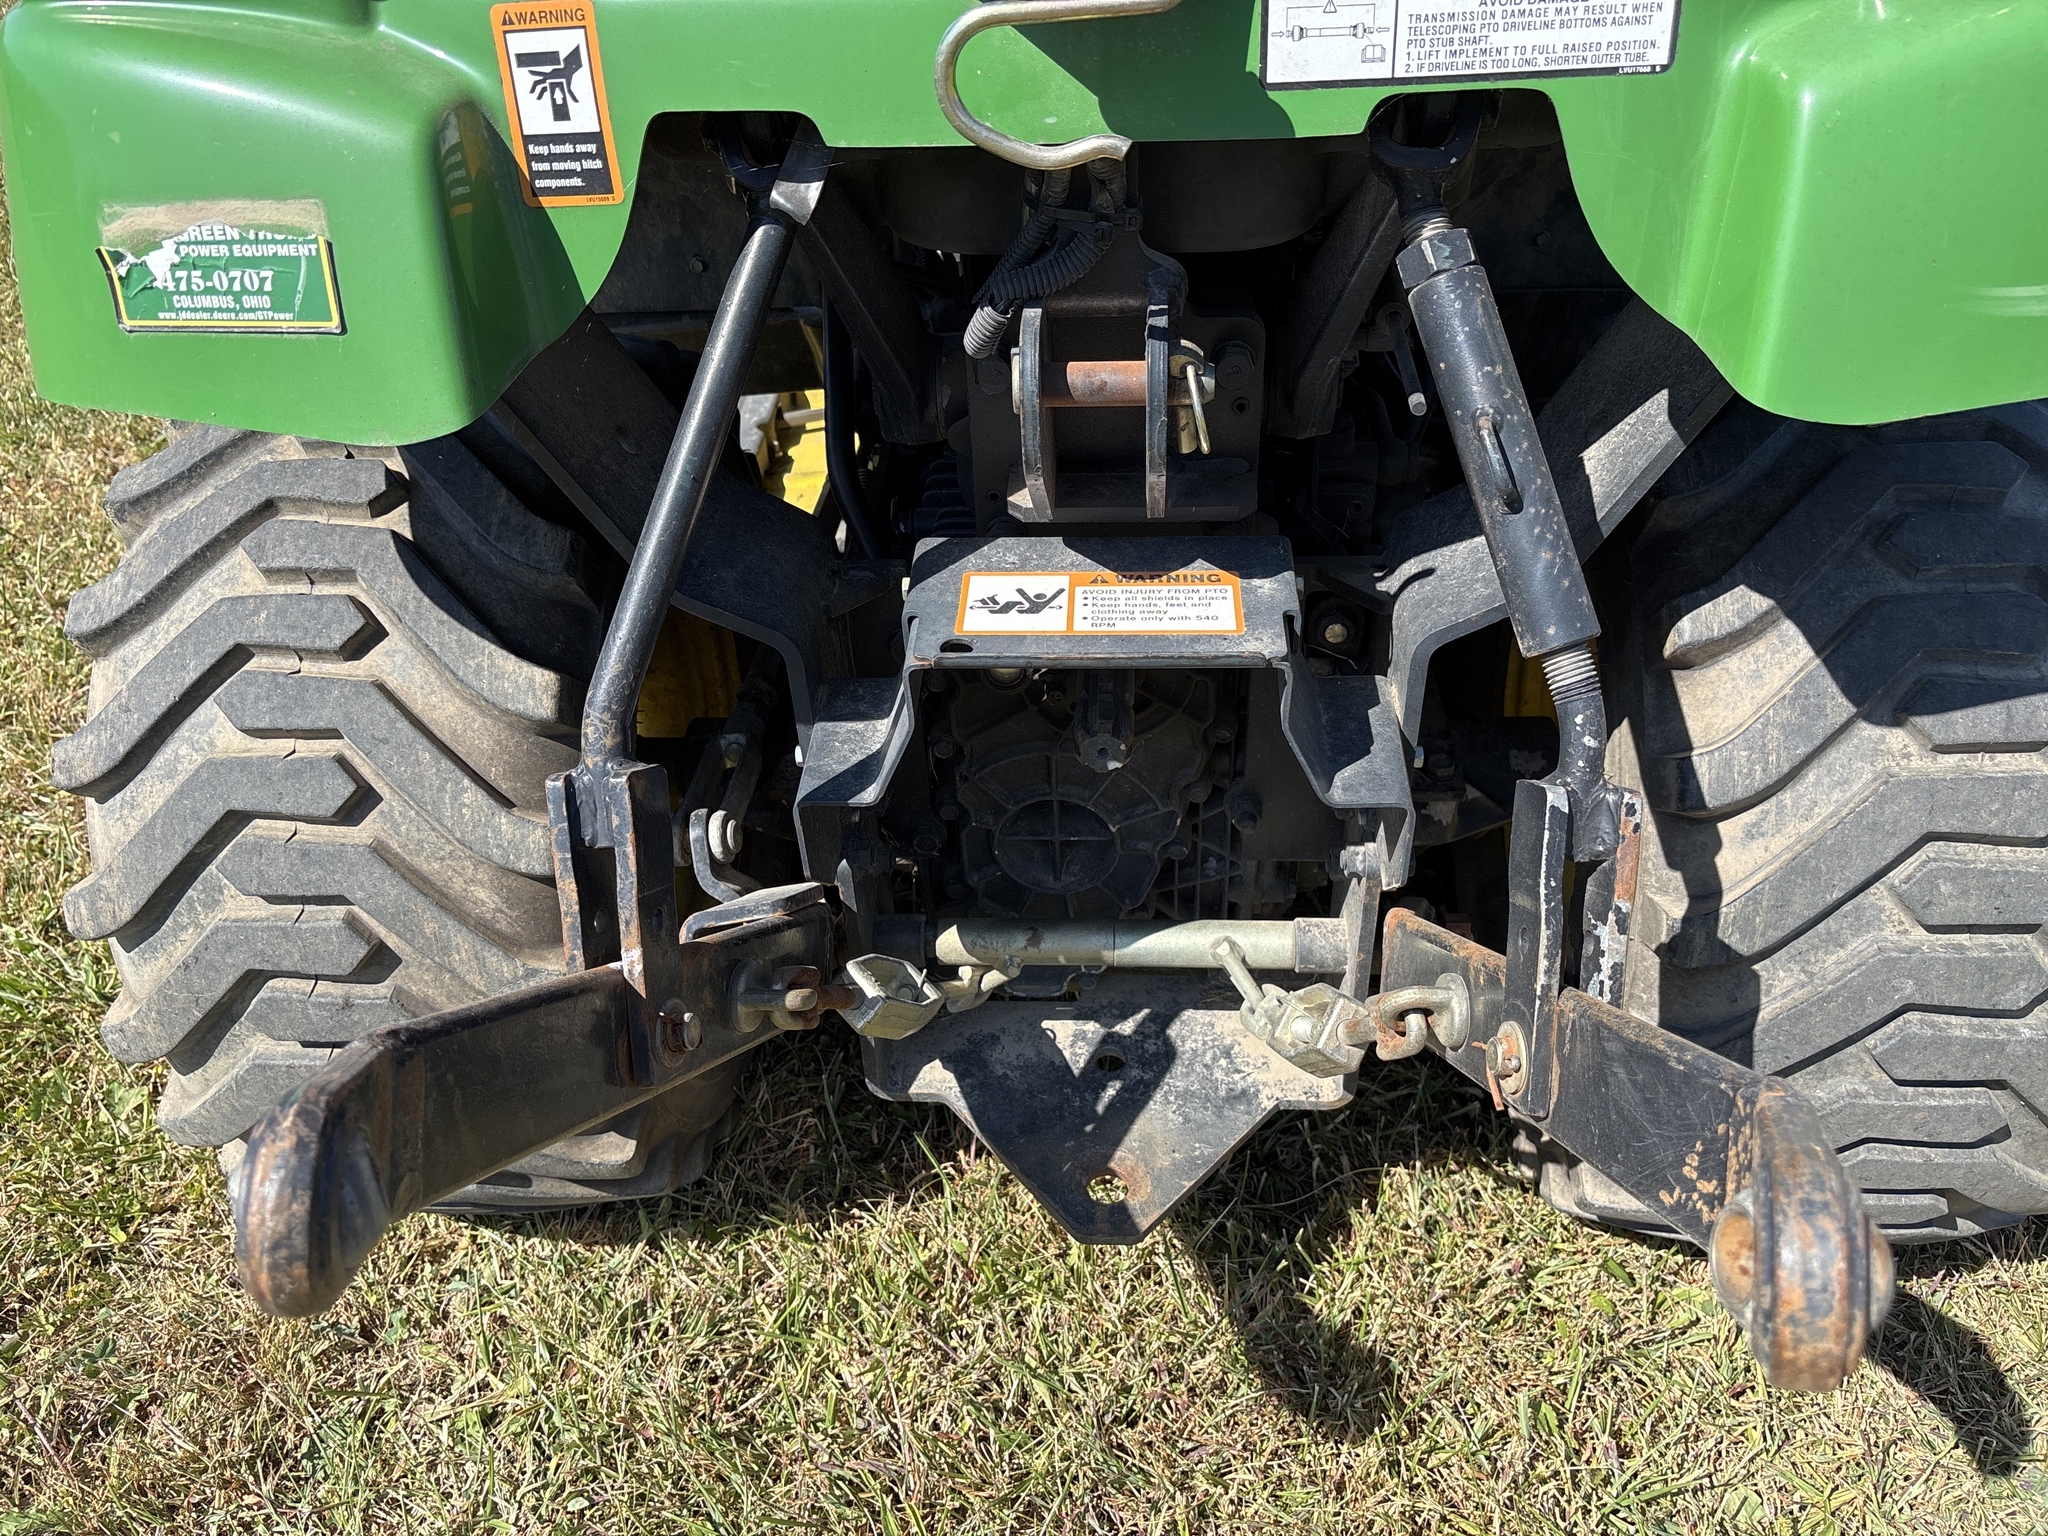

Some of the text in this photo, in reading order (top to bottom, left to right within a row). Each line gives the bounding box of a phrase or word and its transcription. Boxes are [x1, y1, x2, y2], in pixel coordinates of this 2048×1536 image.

[514, 8, 586, 25] WARNING
[1407, 2, 1663, 24] TRANSMISSION DAMAGE MAY RESULT WHEN
[1407, 14, 1654, 37] TELESCOPING PTO DRIVELINE BOTTOMS AGAINST
[1406, 35, 1493, 49] PTO STUB SHAFT.
[1406, 39, 1660, 61] 1. LIFT IMPLEMENT TO FULL RAISED POSITION.
[1405, 51, 1650, 73] 2. IF DRIVELINE IS TOO LONG, SHORTEN OUTER TUBE.
[528, 143, 597, 156] Keep hands away
[531, 159, 603, 172] from moving hitch
[535, 177, 586, 190] components.
[180, 244, 318, 257] POWER EQUIPMENT
[162, 270, 274, 292] 475-0707
[172, 295, 271, 310] COLUMBUS, OHIO
[1114, 573, 1222, 583] WARNING
